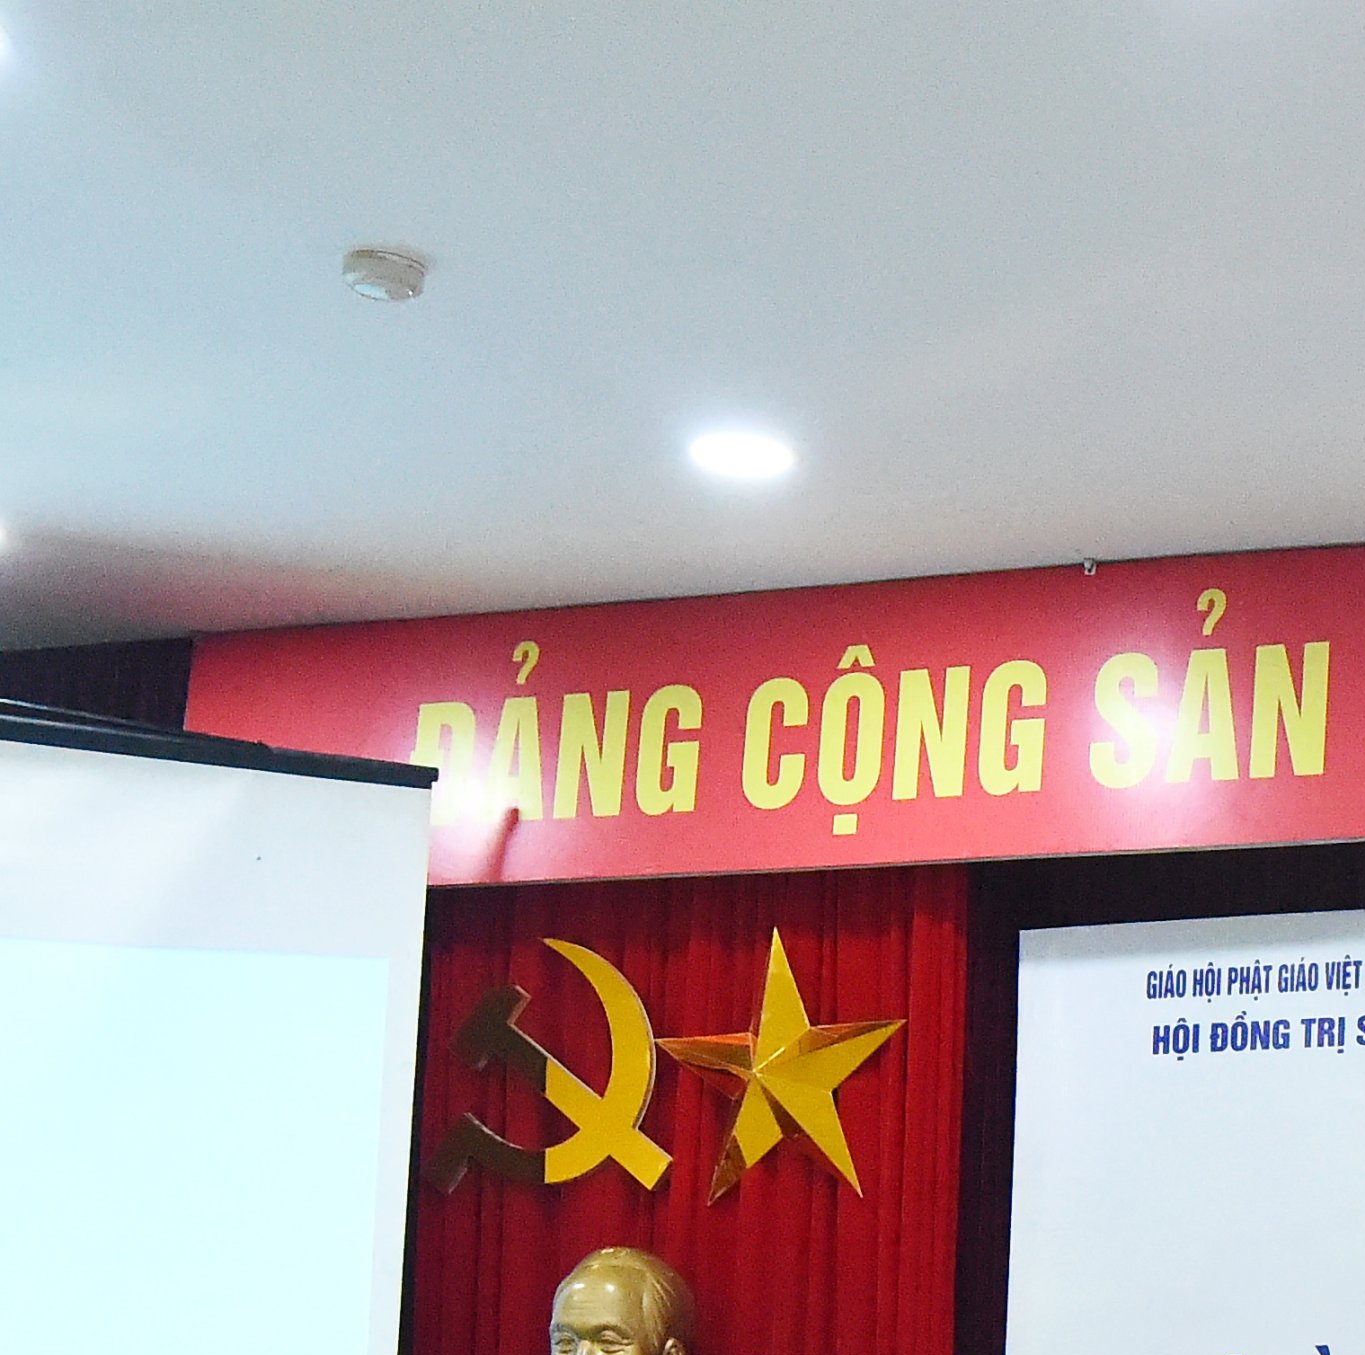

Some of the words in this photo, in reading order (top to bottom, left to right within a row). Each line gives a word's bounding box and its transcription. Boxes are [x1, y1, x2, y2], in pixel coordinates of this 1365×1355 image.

[409, 641, 703, 825] ĐẢNG
[743, 645, 1046, 835] CỘNG
[1089, 588, 1330, 789] SẢN
[1147, 966, 1187, 1000] GIÁO
[1191, 962, 1222, 1004] HỘI
[1227, 960, 1273, 1002] PHẬT
[1278, 959, 1320, 993] GIÁO
[1326, 956, 1364, 996] VIỆT
[1152, 1017, 1201, 1061] HỘI
[1209, 1012, 1291, 1053] ĐỒNG
[1300, 1017, 1346, 1058] TRỊ
